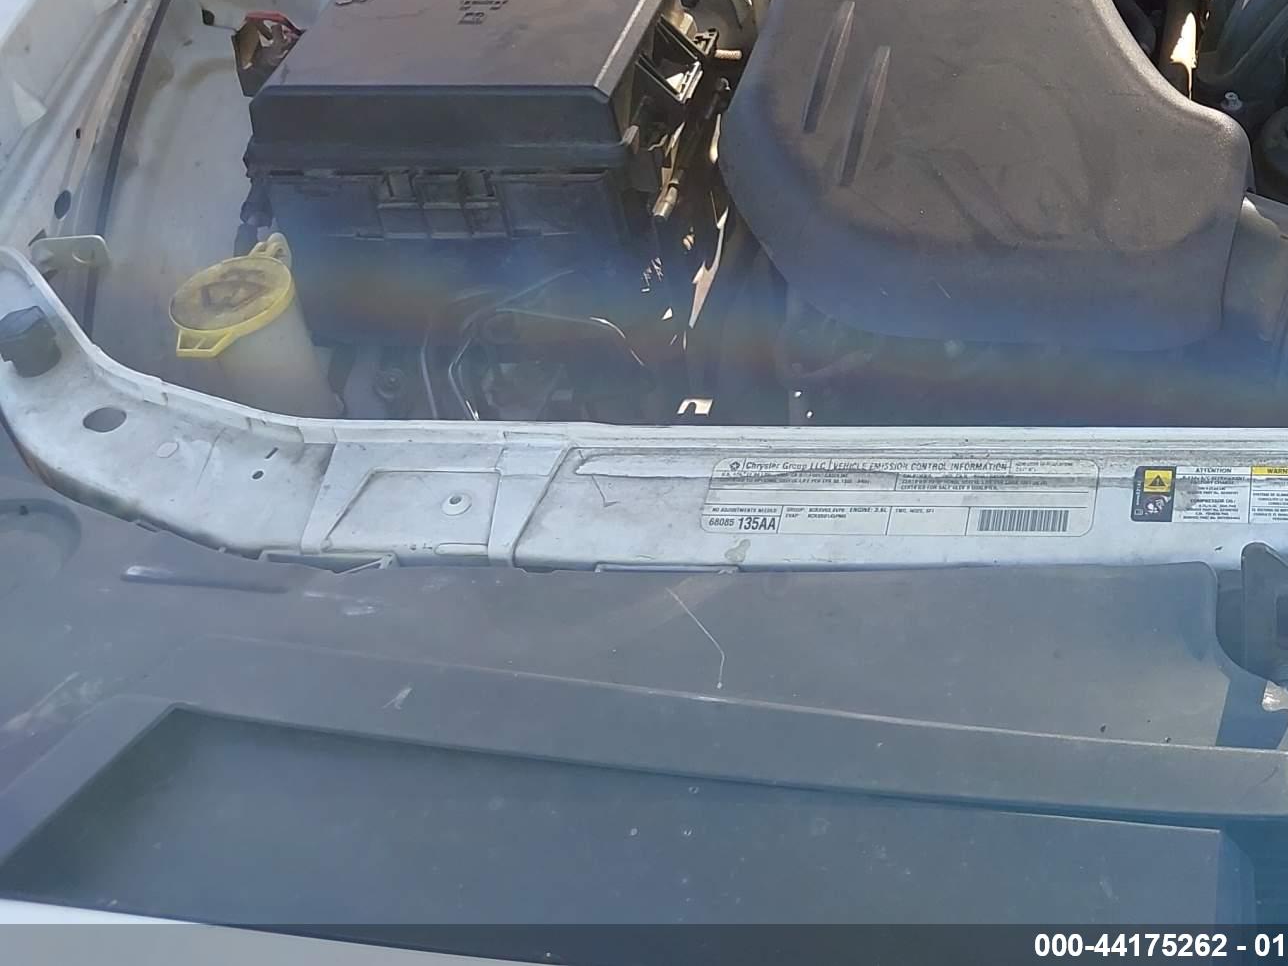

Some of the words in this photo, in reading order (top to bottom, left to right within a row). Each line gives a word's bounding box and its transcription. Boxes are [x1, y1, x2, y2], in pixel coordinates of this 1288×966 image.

[746, 461, 780, 471] Chrysler
[782, 462, 808, 471] Group
[810, 462, 826, 471] LLC
[833, 462, 868, 471] VEHICLE
[870, 462, 908, 471] EMISSION
[910, 462, 945, 471] CONTROL
[950, 462, 1007, 471] INFORMATION
[708, 517, 735, 526] 68085
[738, 517, 776, 531] 135AA
